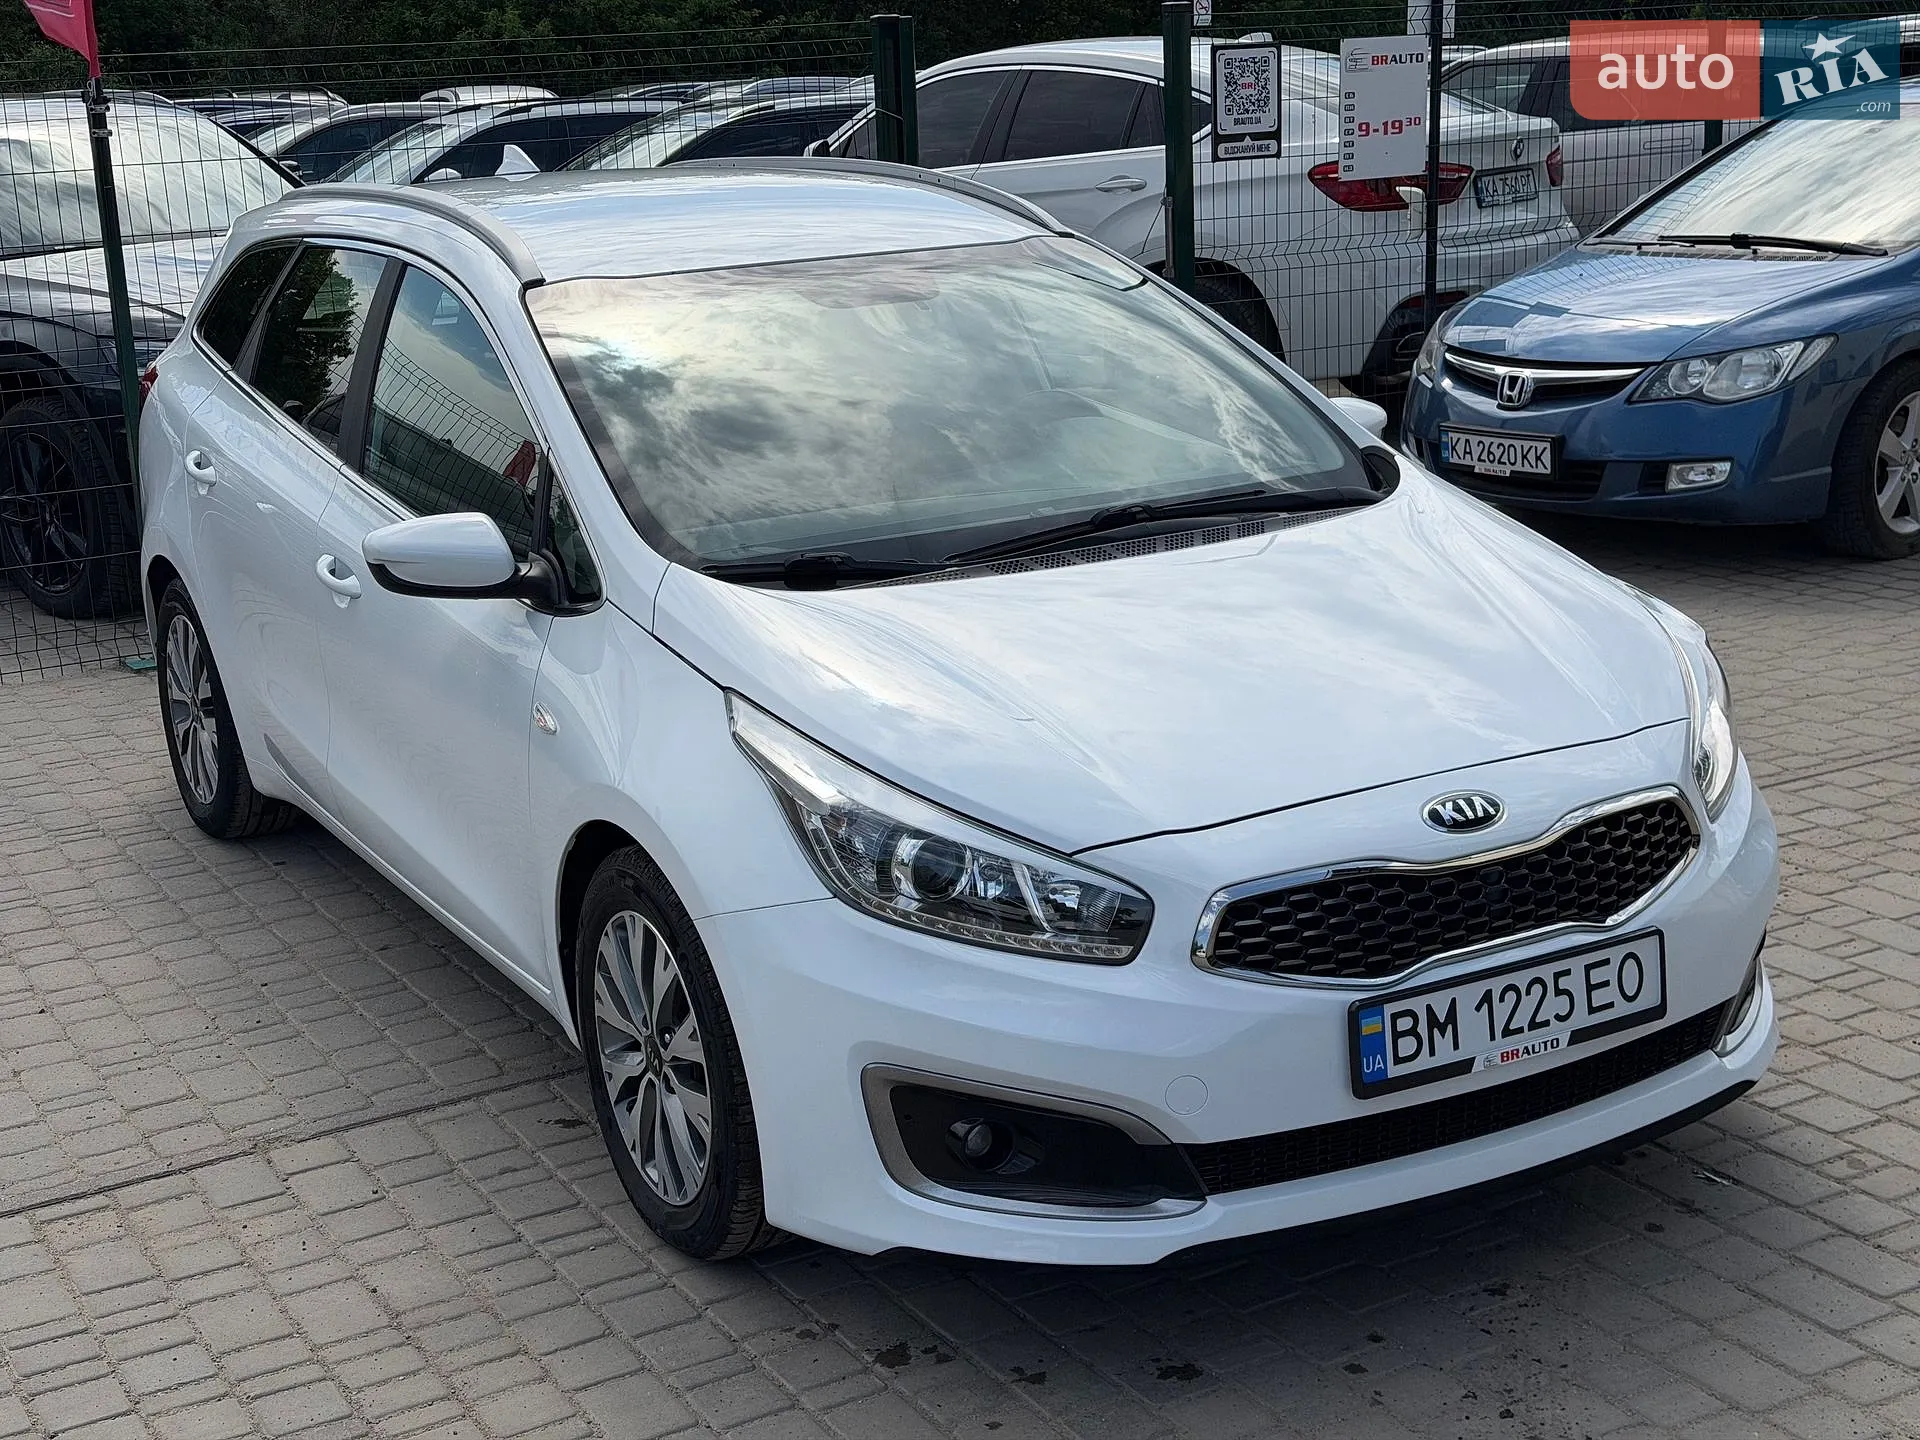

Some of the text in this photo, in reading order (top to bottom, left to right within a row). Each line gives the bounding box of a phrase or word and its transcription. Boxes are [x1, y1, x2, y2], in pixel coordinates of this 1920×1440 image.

[1371, 52, 1424, 66] BRAUTO
[1450, 437, 1549, 470] KA 2620 KK
[1433, 796, 1496, 825] KIA
[1390, 951, 1644, 1066] BM 1225 EO
[1363, 1056, 1385, 1073] UA
[1500, 1037, 1560, 1064] BRAUTO
